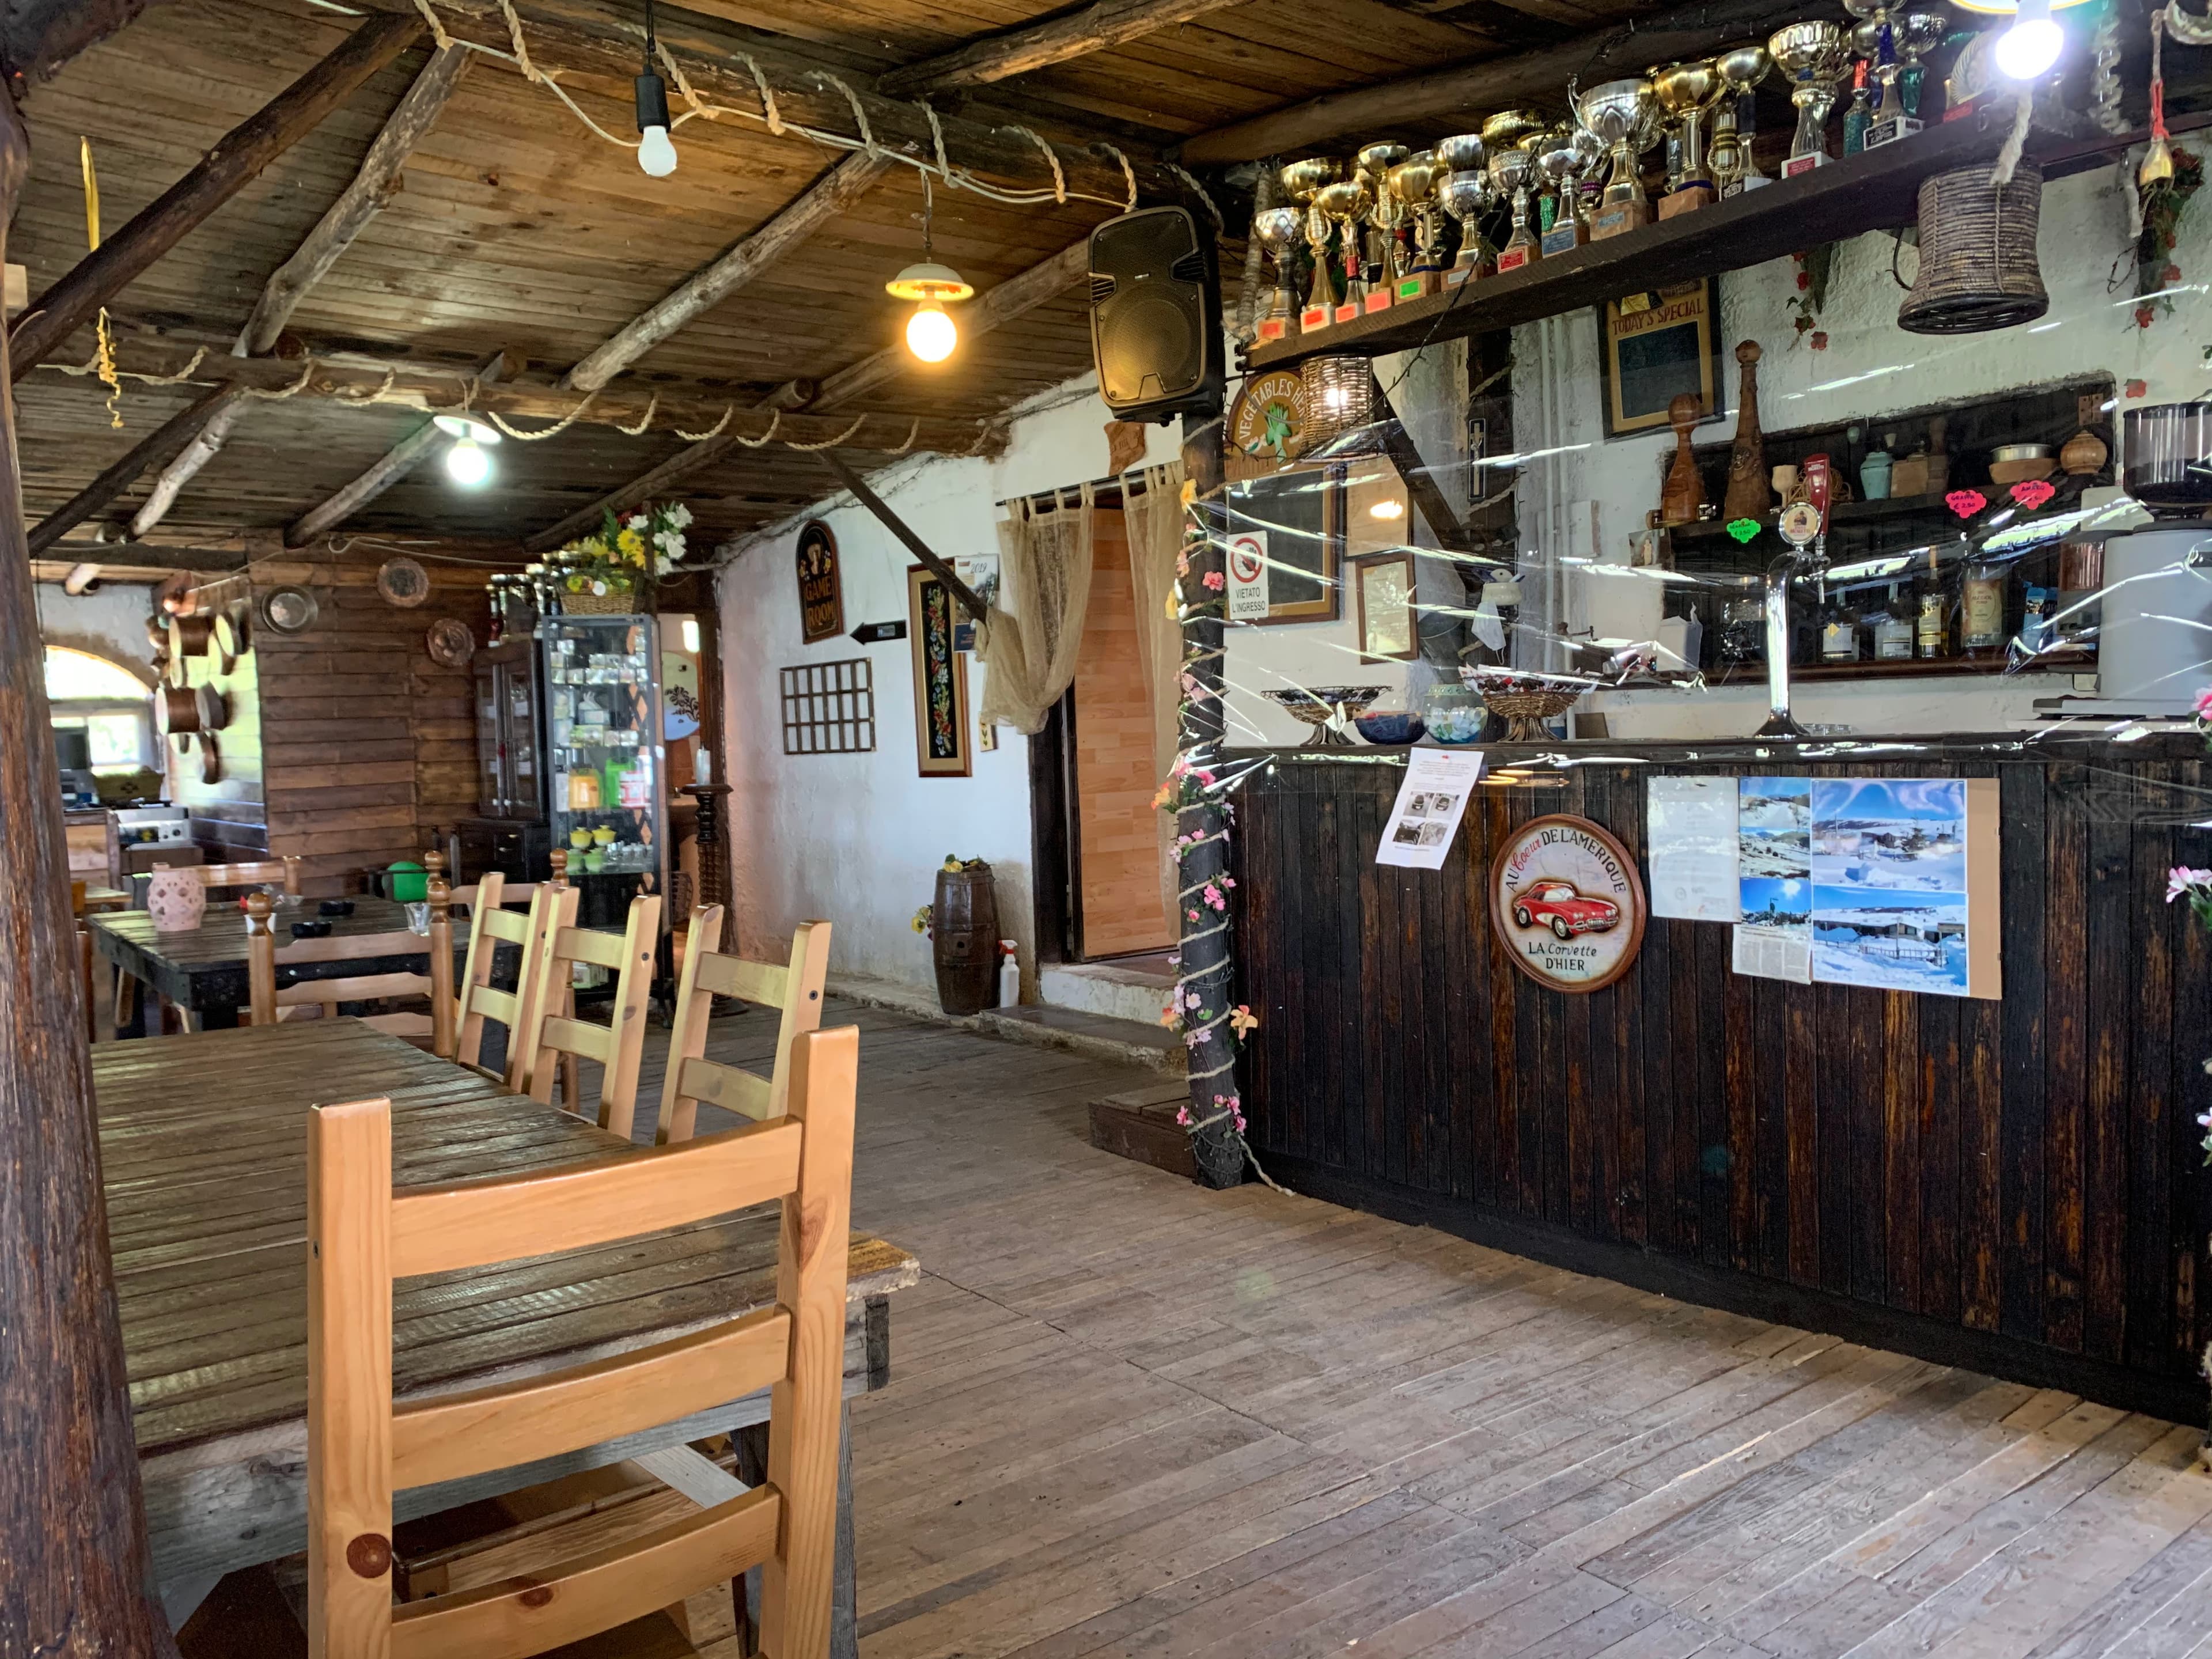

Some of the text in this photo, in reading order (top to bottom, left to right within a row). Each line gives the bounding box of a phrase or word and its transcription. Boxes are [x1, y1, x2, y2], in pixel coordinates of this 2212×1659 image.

[1612, 298, 1703, 335] TODAY'S SPECIAL
[1239, 378, 1294, 439] VEGETABLES
[971, 562, 987, 574] 2019
[806, 576, 832, 601] GAME
[1236, 586, 1260, 599] VIETATO
[808, 601, 834, 627] ROOM
[1232, 600, 1266, 613] L'INGRESSO
[1511, 838, 1541, 871] Coeur
[1506, 868, 1520, 893] AU
[1528, 941, 1597, 957] LA Corvette
[1546, 957, 1585, 971] D'HIER
